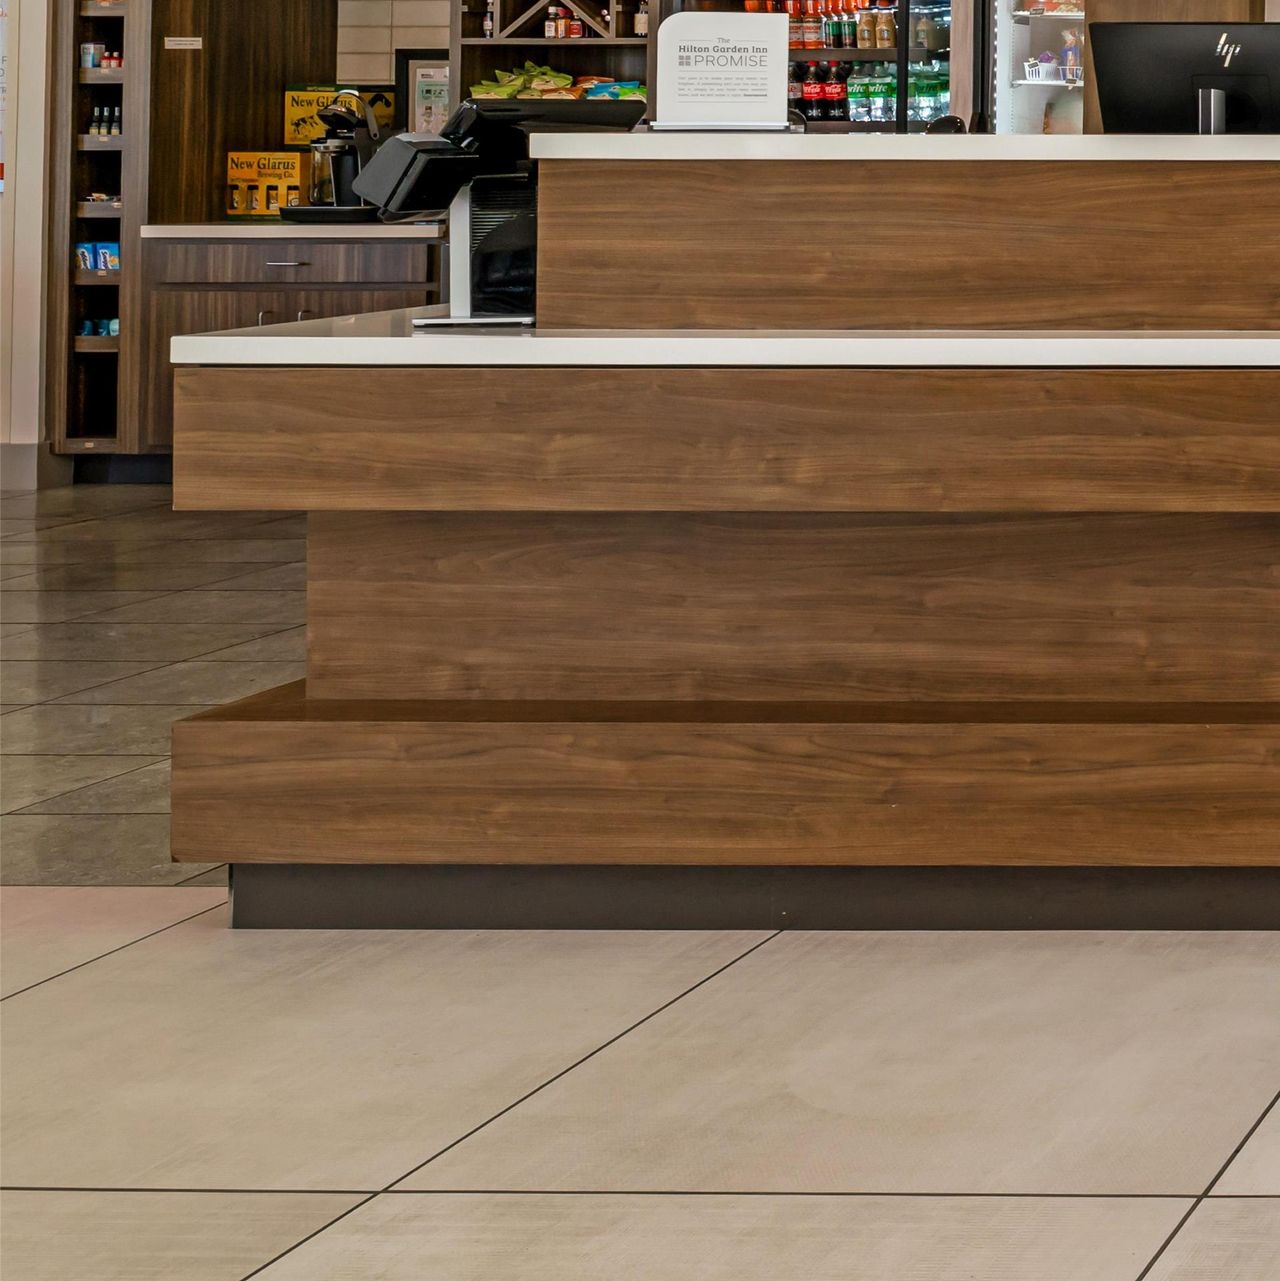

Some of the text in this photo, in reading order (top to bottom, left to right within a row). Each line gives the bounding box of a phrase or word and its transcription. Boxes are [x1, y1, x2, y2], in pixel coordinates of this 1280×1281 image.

[678, 45, 768, 53] Hilton Garden Inn
[694, 54, 768, 67] PROMISE
[291, 96, 314, 108] New
[230, 157, 296, 170] New Glarus
